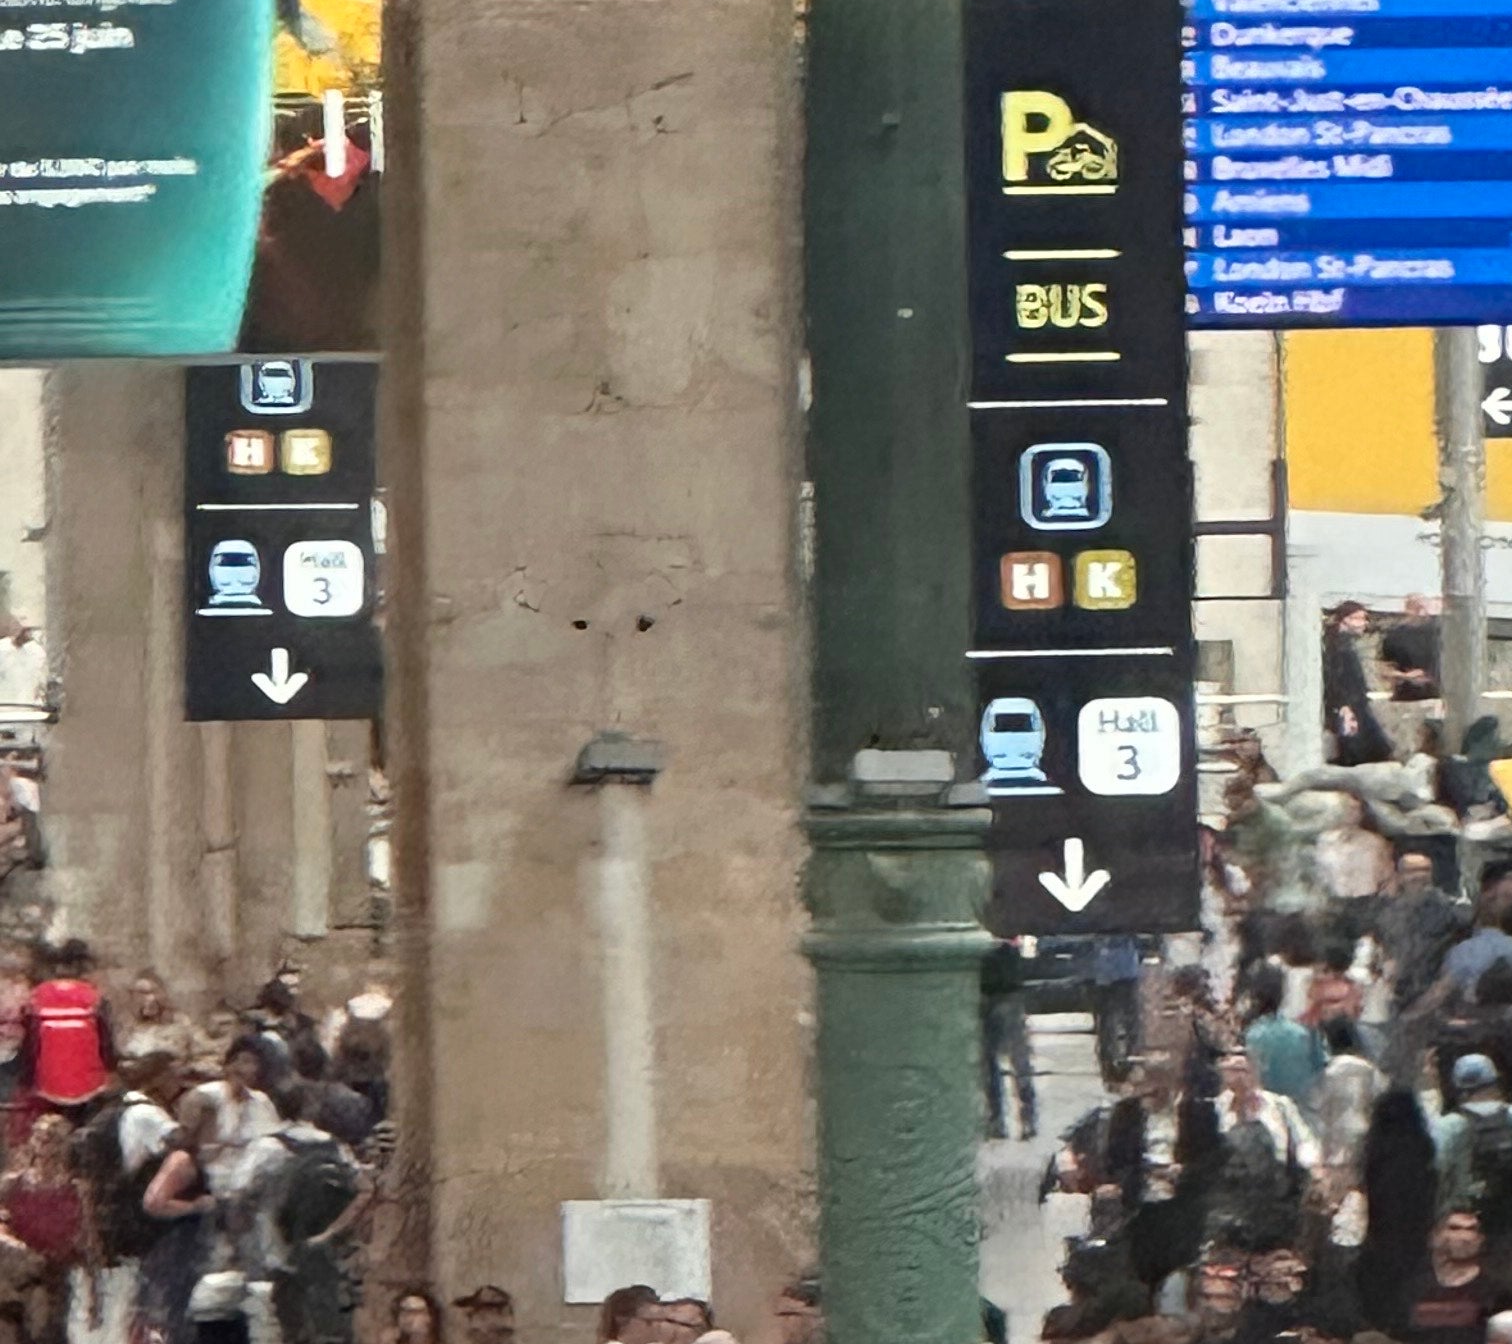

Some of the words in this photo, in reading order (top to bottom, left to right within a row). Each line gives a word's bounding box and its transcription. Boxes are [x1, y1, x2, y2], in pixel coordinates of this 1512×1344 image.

[1210, 22, 1354, 50] Dunkerque
[1001, 90, 1073, 181] P
[1212, 224, 1279, 248] Laon
[1015, 283, 1108, 329] BUS
[311, 577, 333, 605] 3
[1012, 562, 1050, 601] H
[1087, 561, 1123, 599] K
[1116, 744, 1142, 781] 3
